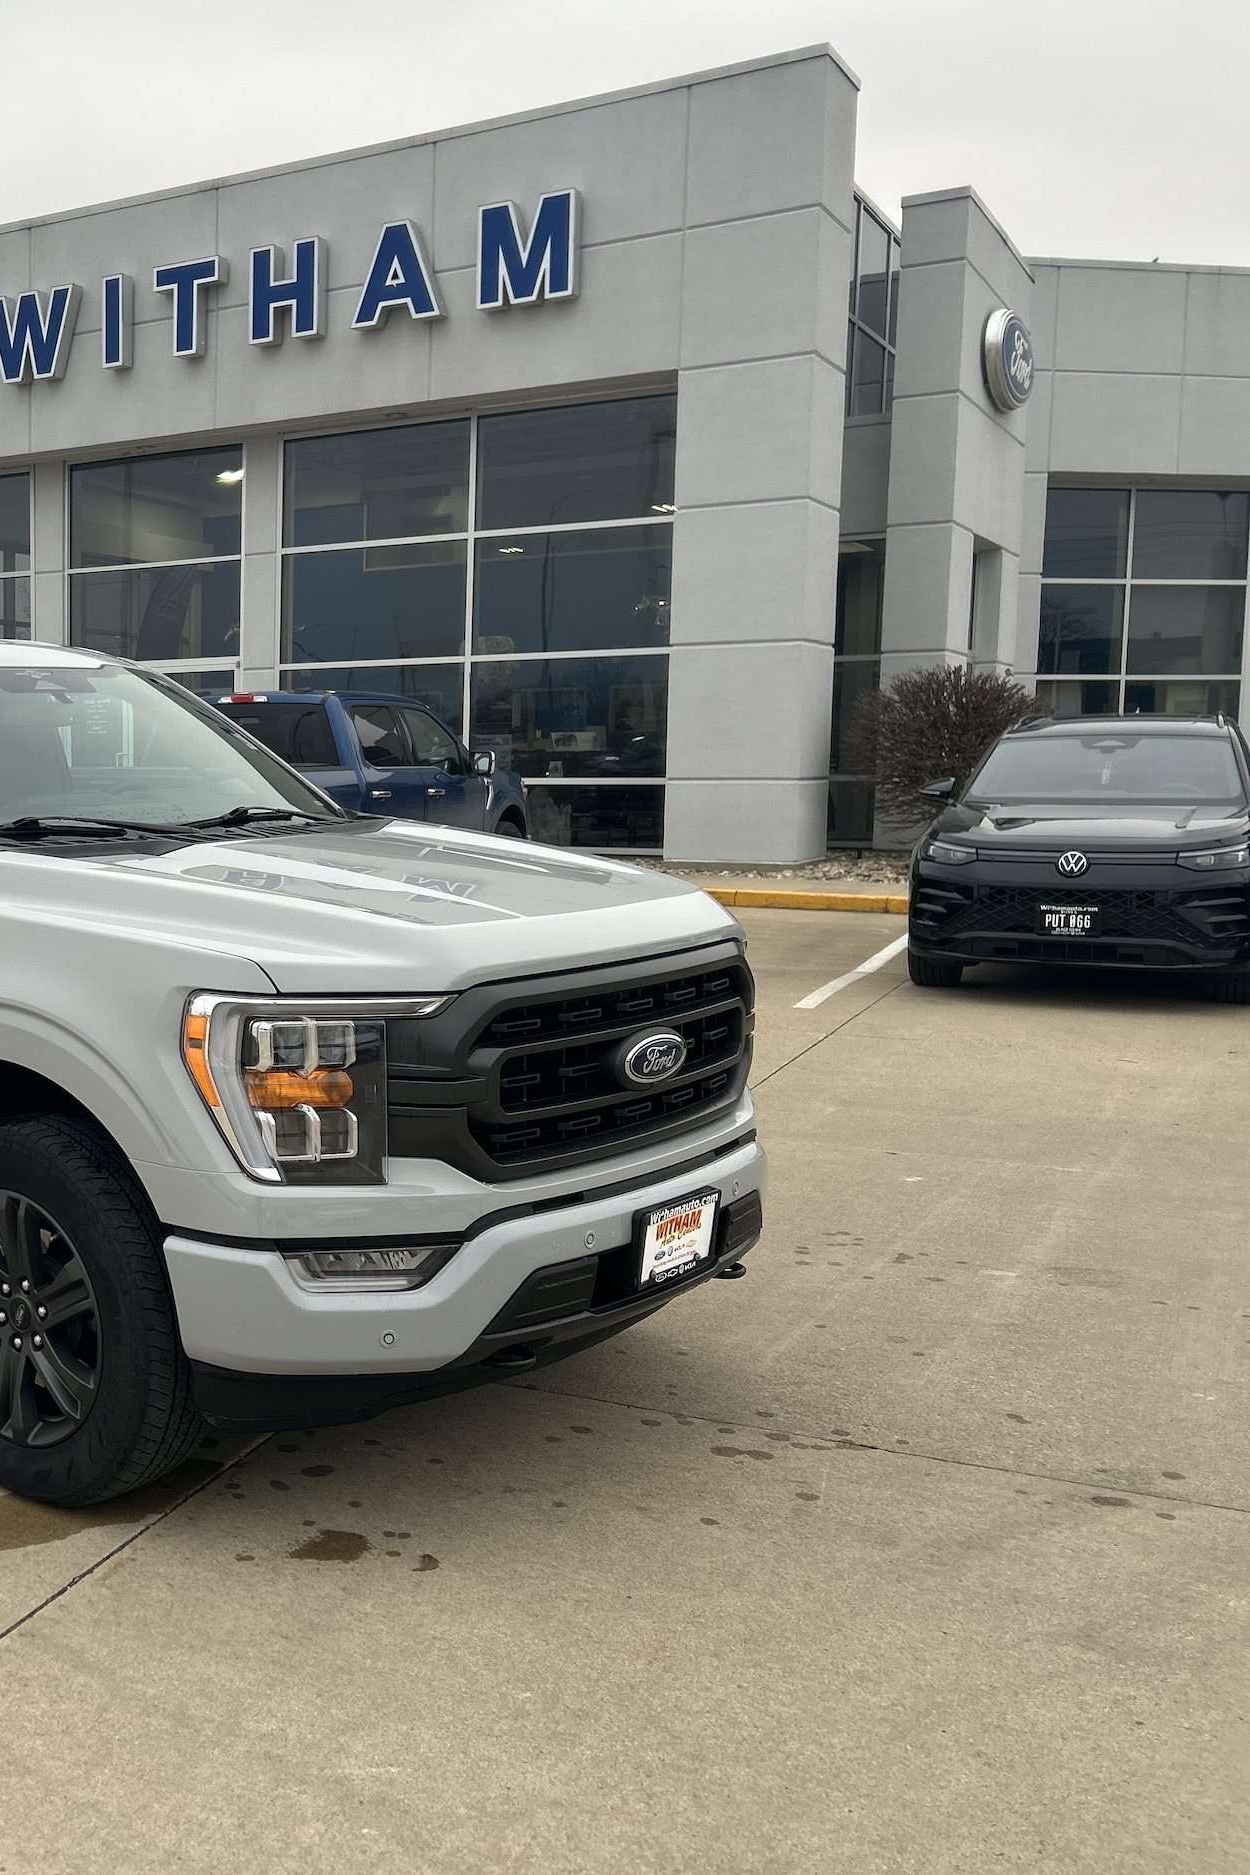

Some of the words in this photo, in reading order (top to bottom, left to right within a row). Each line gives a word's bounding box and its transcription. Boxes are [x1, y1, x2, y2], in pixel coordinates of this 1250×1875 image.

[1010, 330, 1033, 390] Ford
[1045, 913, 1067, 928] PUT
[642, 1044, 677, 1074] Ford
[650, 1193, 719, 1225] Withamauto.com
[656, 1208, 703, 1241] WITHAM
